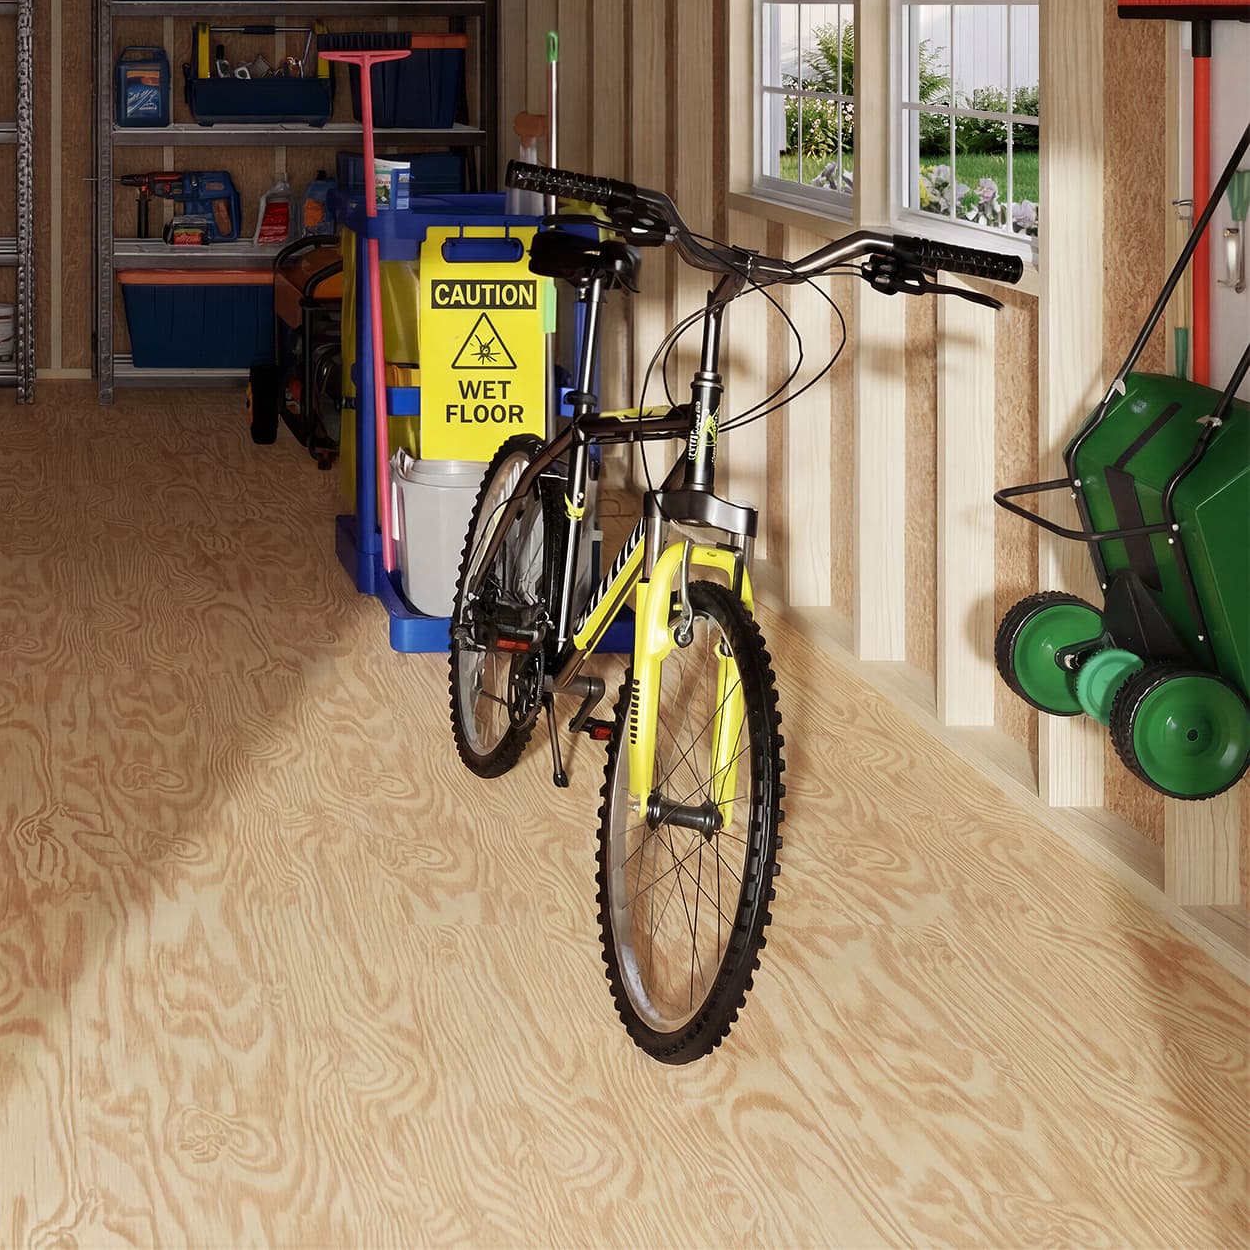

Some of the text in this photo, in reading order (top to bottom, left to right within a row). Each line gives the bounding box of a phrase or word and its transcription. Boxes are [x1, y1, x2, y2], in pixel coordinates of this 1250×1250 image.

[434, 283, 534, 306] CAUTION
[458, 380, 512, 400] WET
[446, 404, 524, 424] FLOOR
